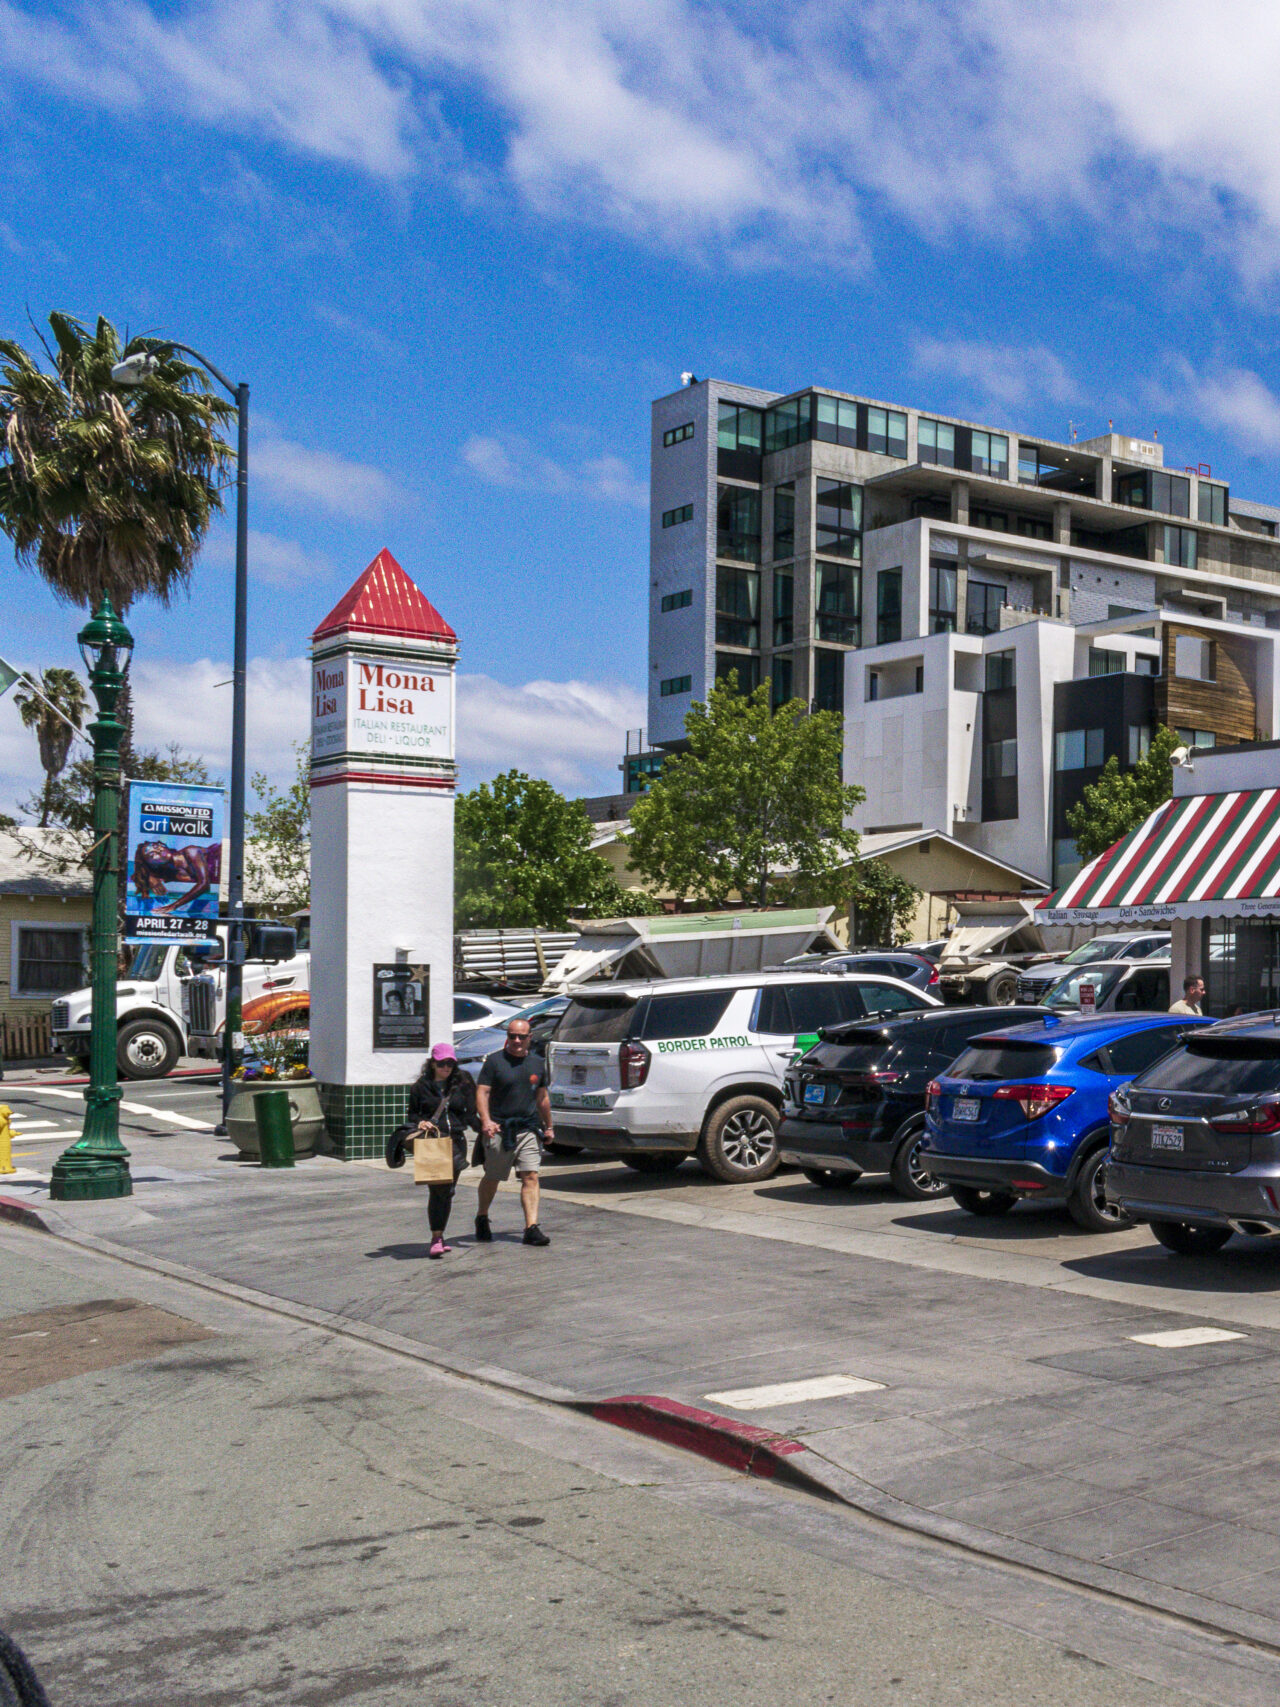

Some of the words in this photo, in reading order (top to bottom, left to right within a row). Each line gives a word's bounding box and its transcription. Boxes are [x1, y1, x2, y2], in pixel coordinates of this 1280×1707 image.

[316, 670, 344, 692] Mona
[358, 662, 435, 692] Mona
[316, 695, 336, 717] Lisa
[358, 688, 414, 714] Lisa
[354, 719, 387, 730] ITALIAN
[391, 722, 447, 736] RESTAURANT
[368, 733, 386, 743] DELI
[395, 736, 430, 747] LIQUOR
[156, 805, 192, 814] MISSION
[194, 808, 210, 816] FED
[1048, 911, 1067, 919] Italian
[1073, 910, 1098, 920] Sausage
[1120, 908, 1132, 917] Deli
[1138, 905, 1176, 916] Sandwiches
[137, 918, 167, 929] APRIL
[170, 919, 183, 929] 27
[194, 920, 208, 930] 28
[658, 1039, 707, 1052] BORDER
[710, 1036, 752, 1048] PATROL
[581, 1094, 609, 1107] PATROL
